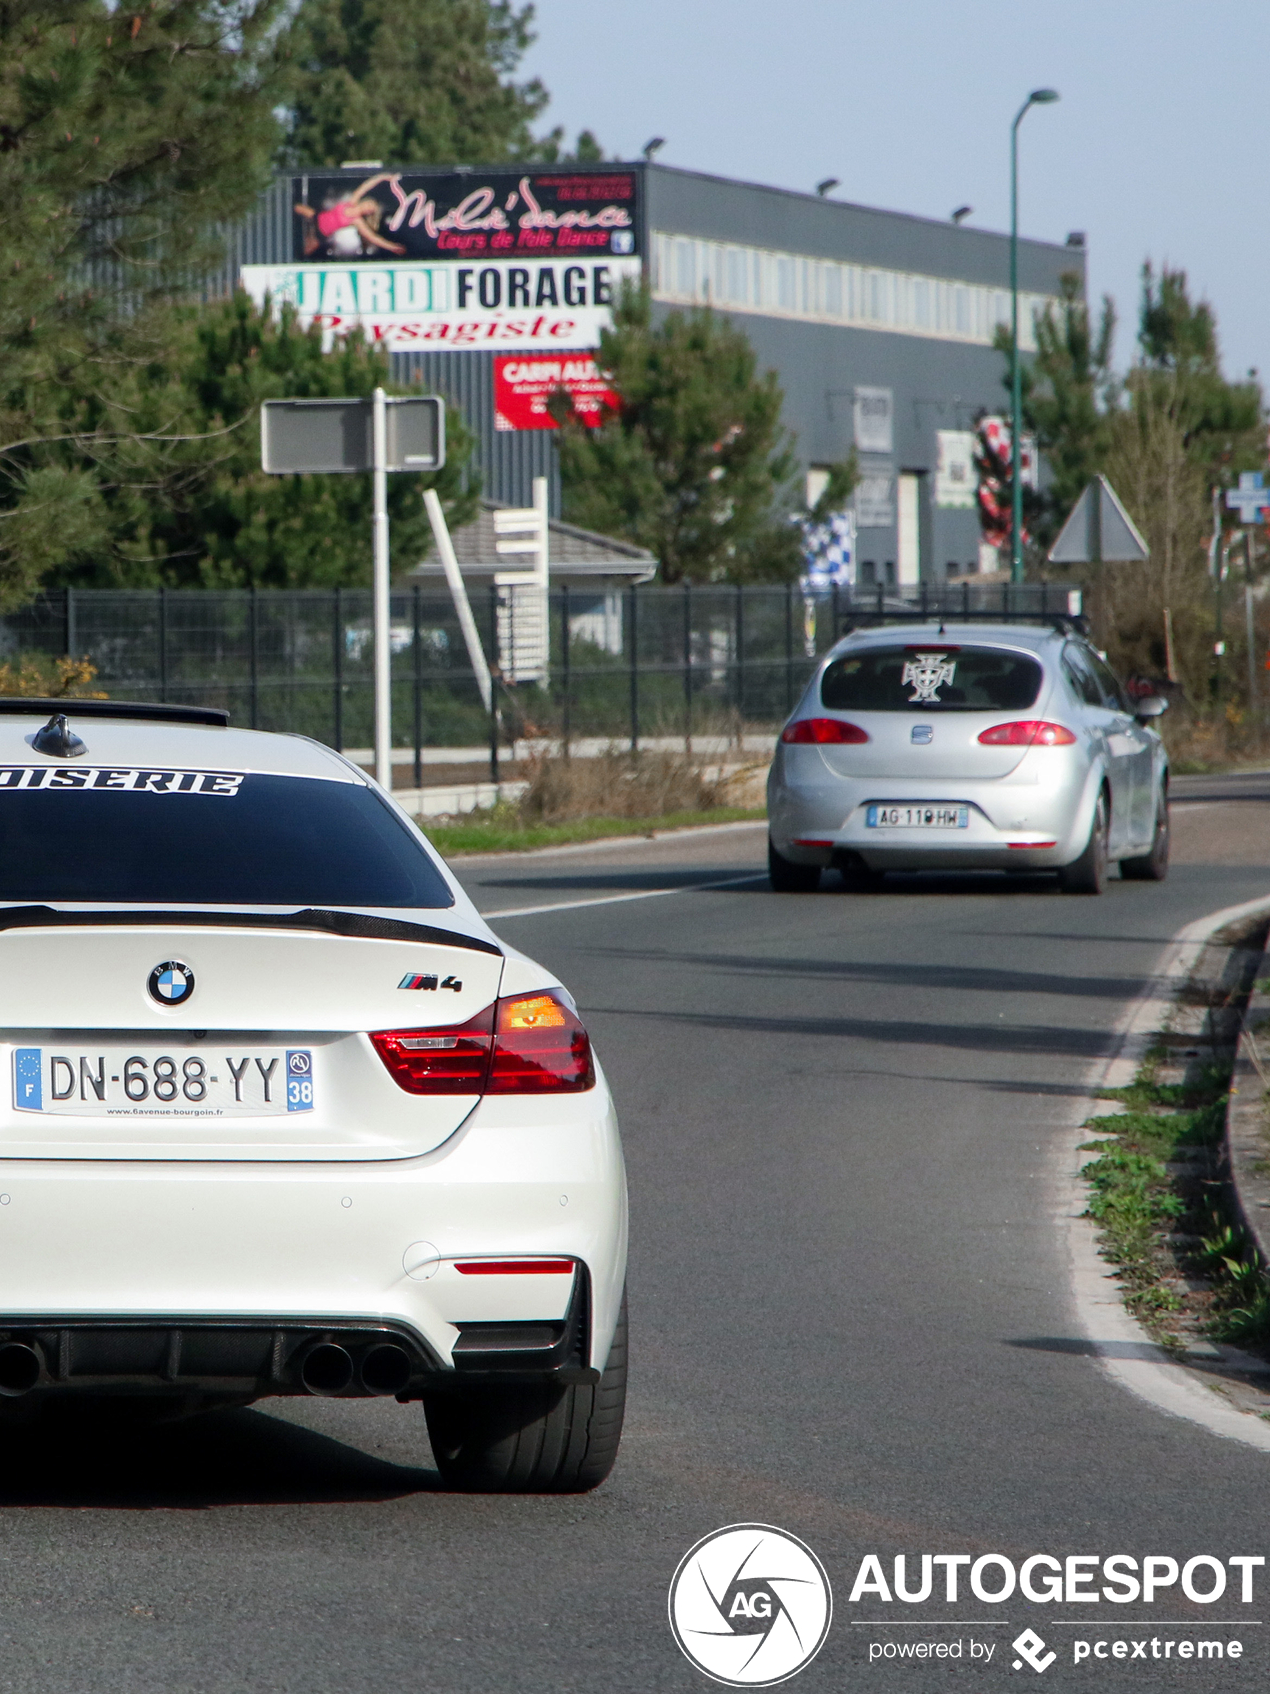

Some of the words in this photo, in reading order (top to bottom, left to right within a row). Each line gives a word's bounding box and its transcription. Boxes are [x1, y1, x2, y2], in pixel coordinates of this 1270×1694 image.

[490, 229, 514, 248] de
[296, 269, 448, 314] JARDI
[458, 266, 610, 308] FORAGE
[153, 960, 192, 977] BMW
[49, 1056, 280, 1102] DN-688-YY
[25, 1083, 34, 1098] F
[289, 1081, 313, 1104] 38
[106, 1107, 224, 1117] www.6avenue-bourgoin.fr
